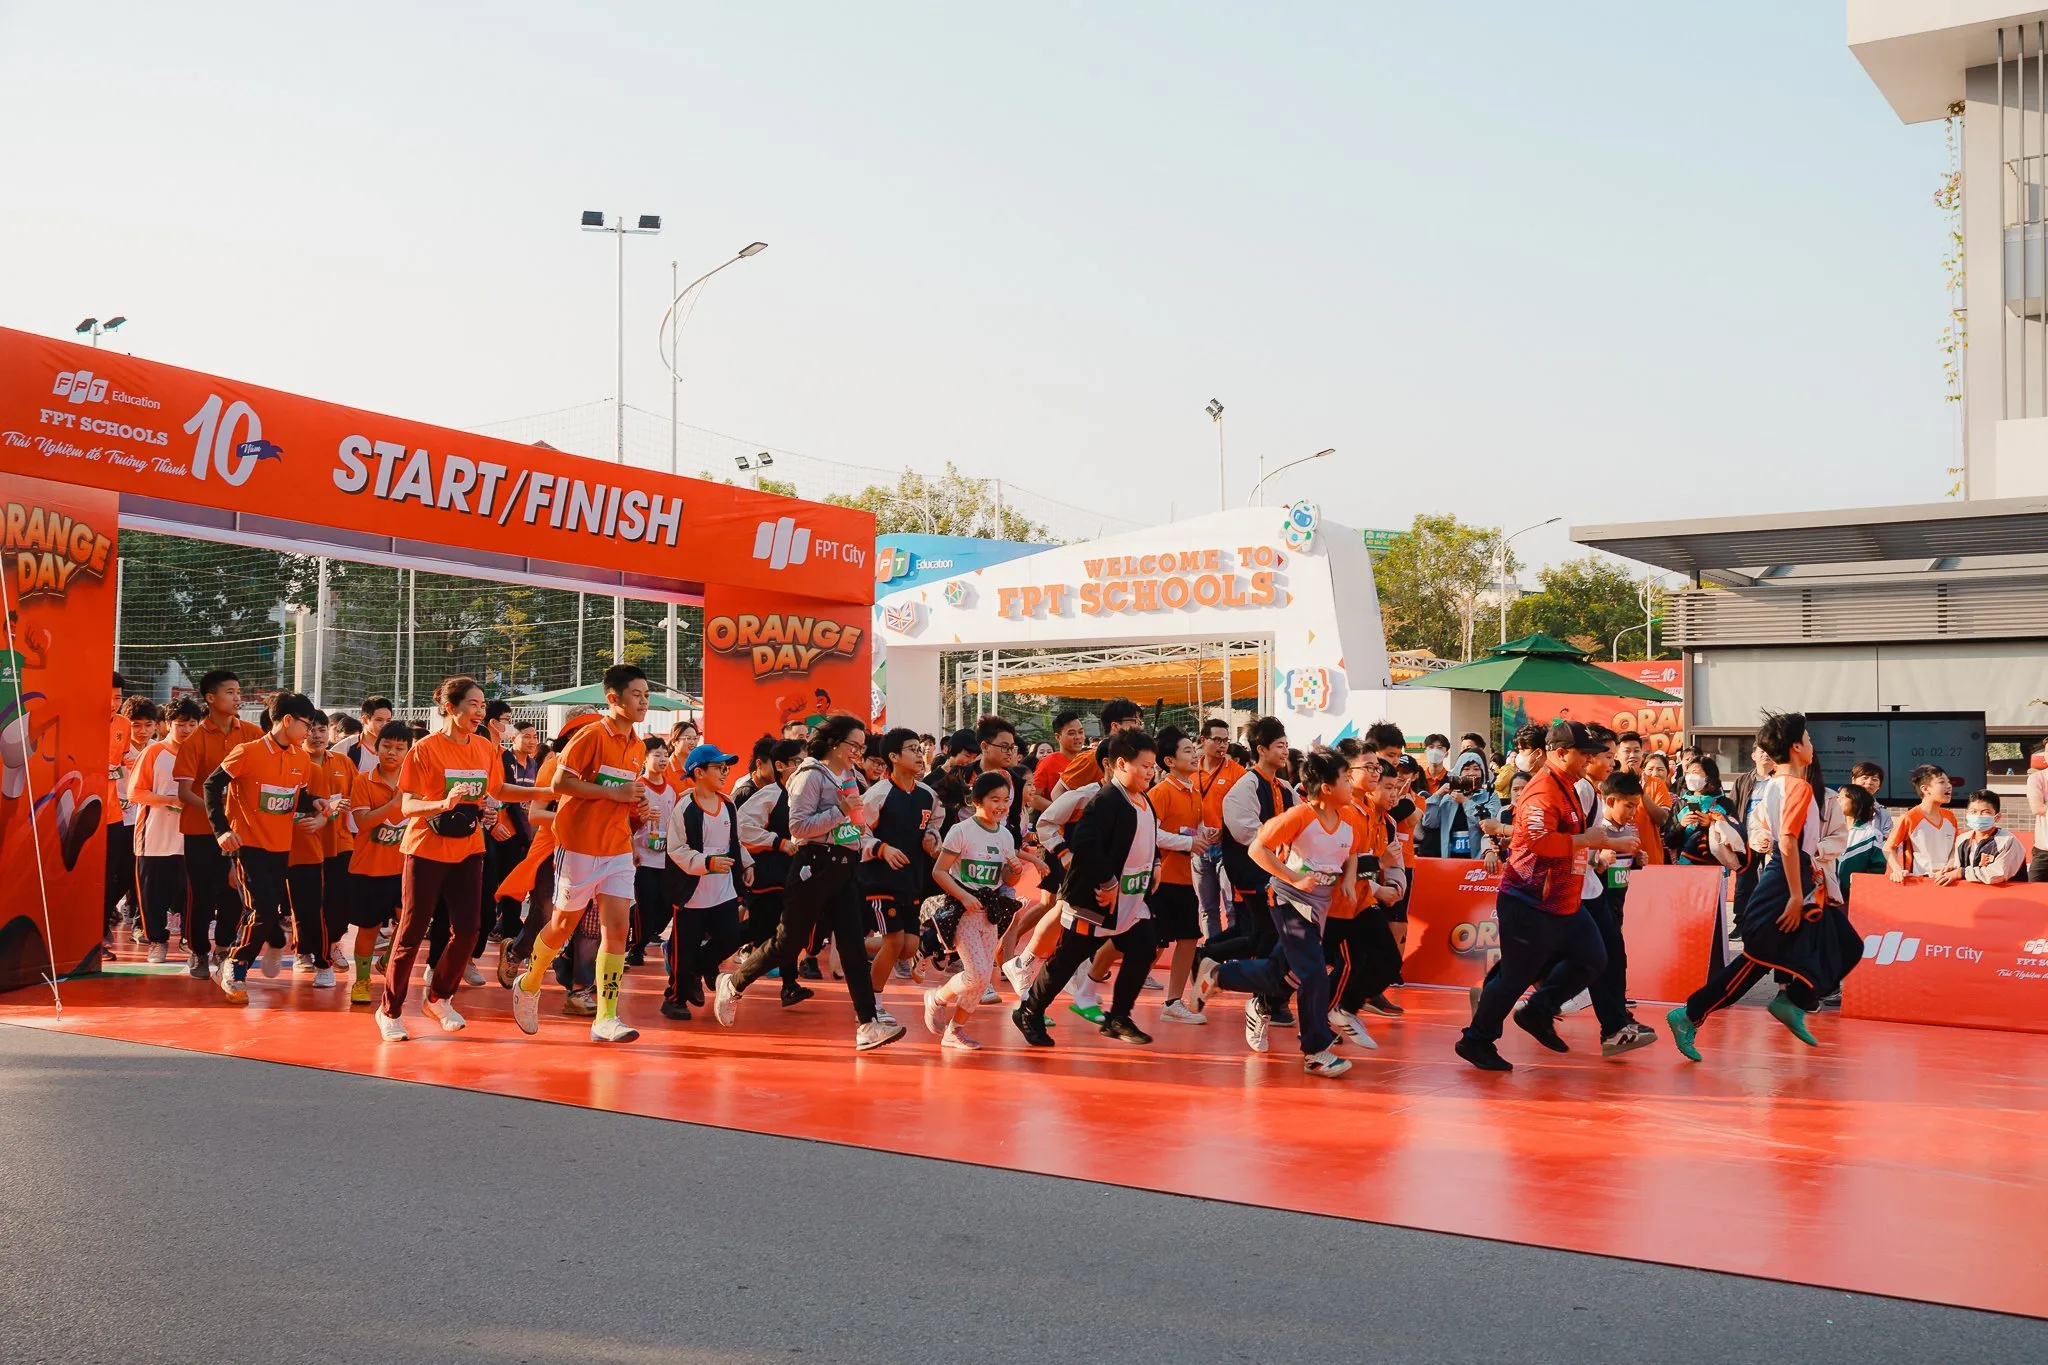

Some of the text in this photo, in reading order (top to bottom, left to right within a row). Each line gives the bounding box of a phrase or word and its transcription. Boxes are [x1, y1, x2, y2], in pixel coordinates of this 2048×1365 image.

[54, 372, 161, 410] FPT Education
[40, 408, 169, 446] FPT SCHOOLS
[183, 393, 262, 487] 10
[333, 434, 684, 547] START/FINISH
[0, 502, 112, 578] RANGE
[815, 537, 866, 569] FPT City
[17, 551, 77, 593] DAY
[915, 558, 954, 571] Education
[1083, 545, 1274, 579] WELCOME TO
[997, 571, 1277, 619] FPT SCHOOLS
[706, 614, 863, 653] ORANGE
[752, 644, 822, 676] DAY
[968, 863, 999, 881] 0277
[1127, 874, 1151, 891] 019
[1924, 944, 1984, 964] FPT City
[2016, 957, 2038, 966] FPT
